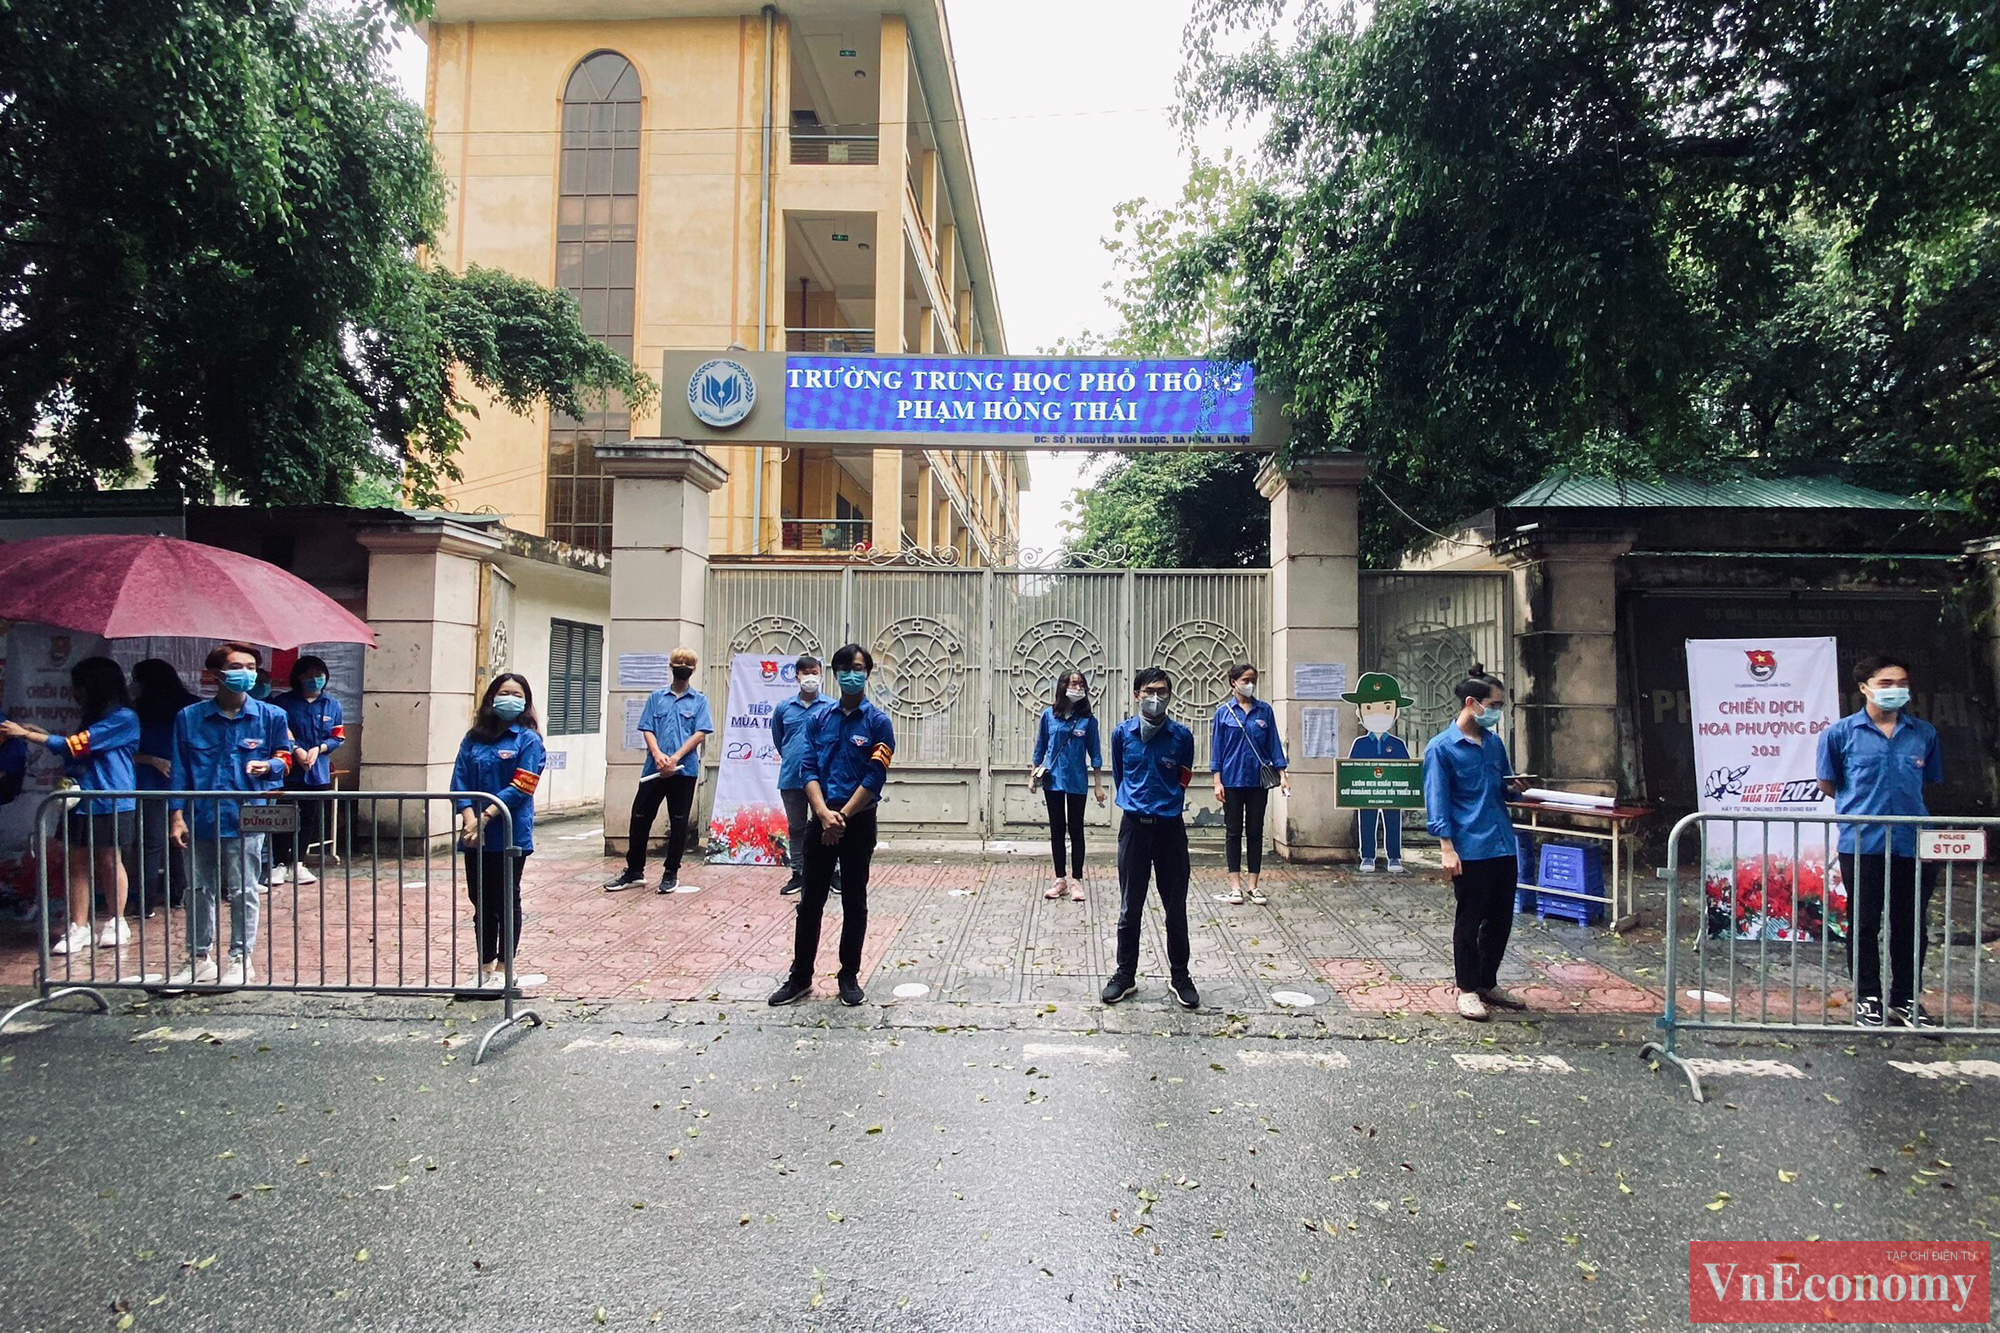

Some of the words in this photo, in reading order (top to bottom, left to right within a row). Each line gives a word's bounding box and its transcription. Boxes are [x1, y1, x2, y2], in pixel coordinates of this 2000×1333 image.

[787, 366, 903, 390] TRƯỜNG
[911, 371, 1004, 392] TRUNG
[1012, 372, 1070, 395] HỌC
[1080, 368, 1136, 392] PHỔ
[896, 400, 975, 424] PHẠM
[982, 397, 1062, 421] HỒNG
[1070, 398, 1138, 421] THÁI
[1172, 436, 1185, 444] BA
[1218, 434, 1231, 444] HÀ
[1234, 434, 1250, 445] NỘI
[1769, 701, 1804, 717] DỊCH
[731, 714, 760, 729] MÙA
[1699, 722, 1731, 736] HOA
[1735, 722, 1806, 738] PHƯỢNG
[1933, 844, 1971, 854] STOP
